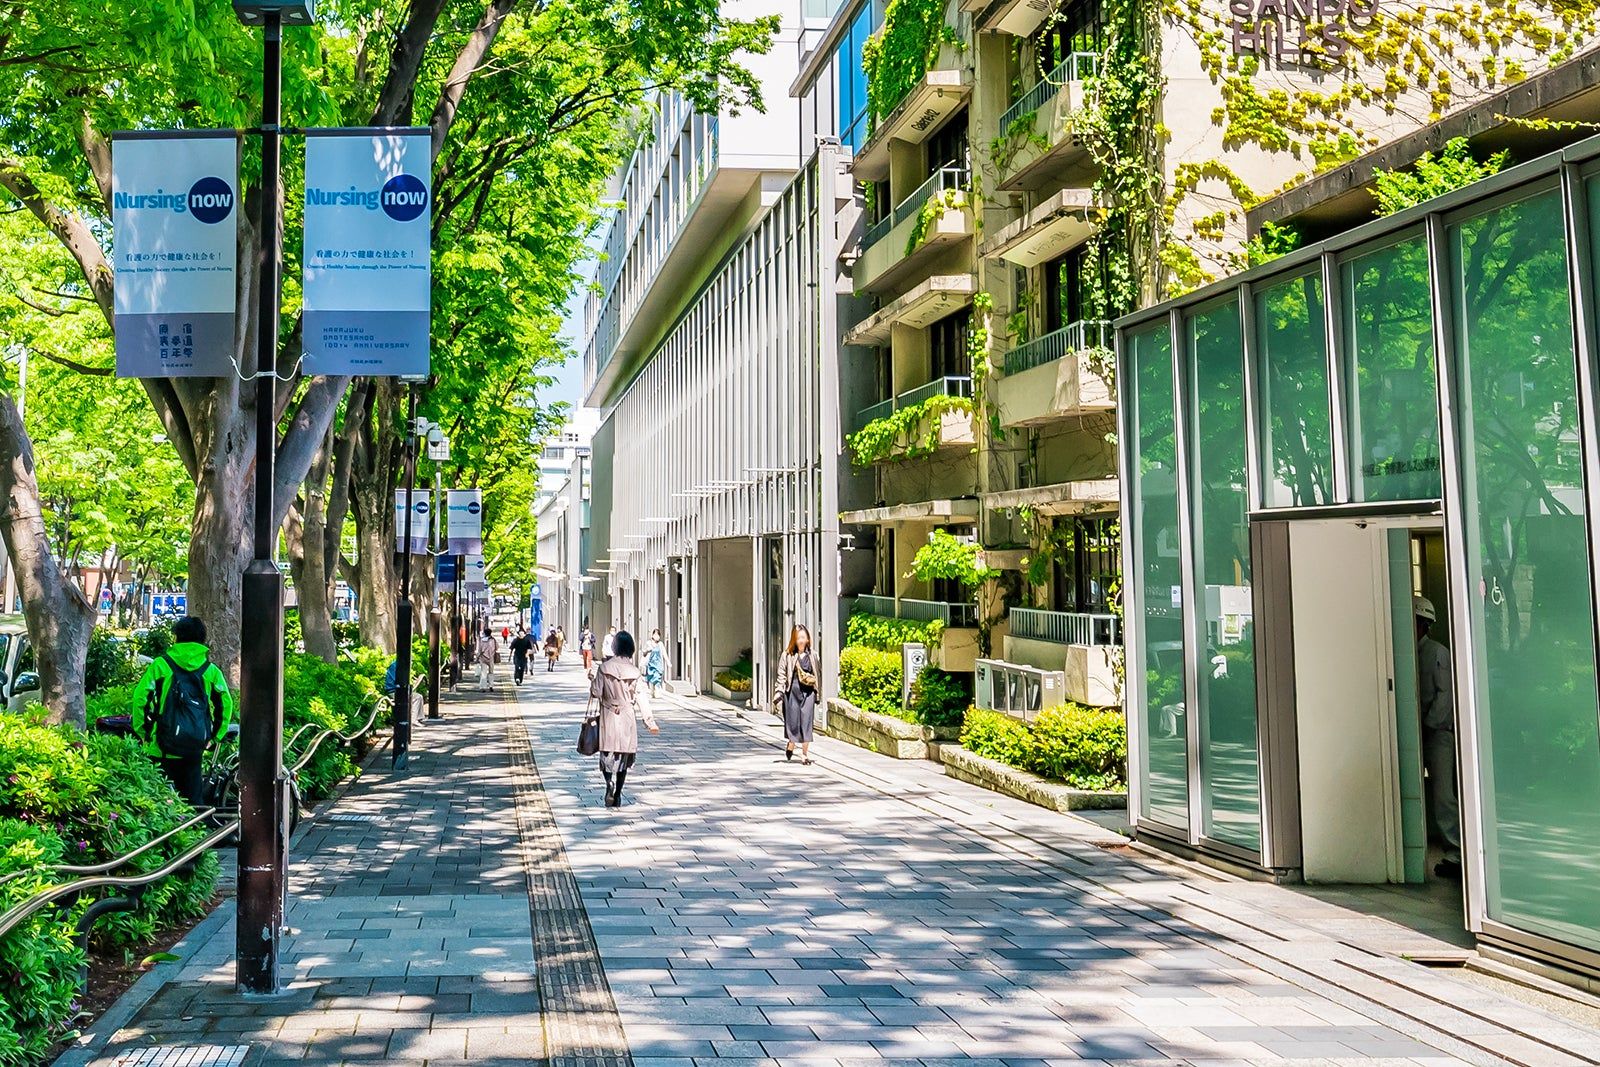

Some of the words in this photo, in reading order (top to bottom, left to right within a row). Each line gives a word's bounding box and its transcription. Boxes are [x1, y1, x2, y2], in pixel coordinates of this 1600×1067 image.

[114, 189, 187, 213] Nursing
[191, 193, 232, 208] now
[306, 186, 379, 210] Nursing
[384, 191, 426, 206] now
